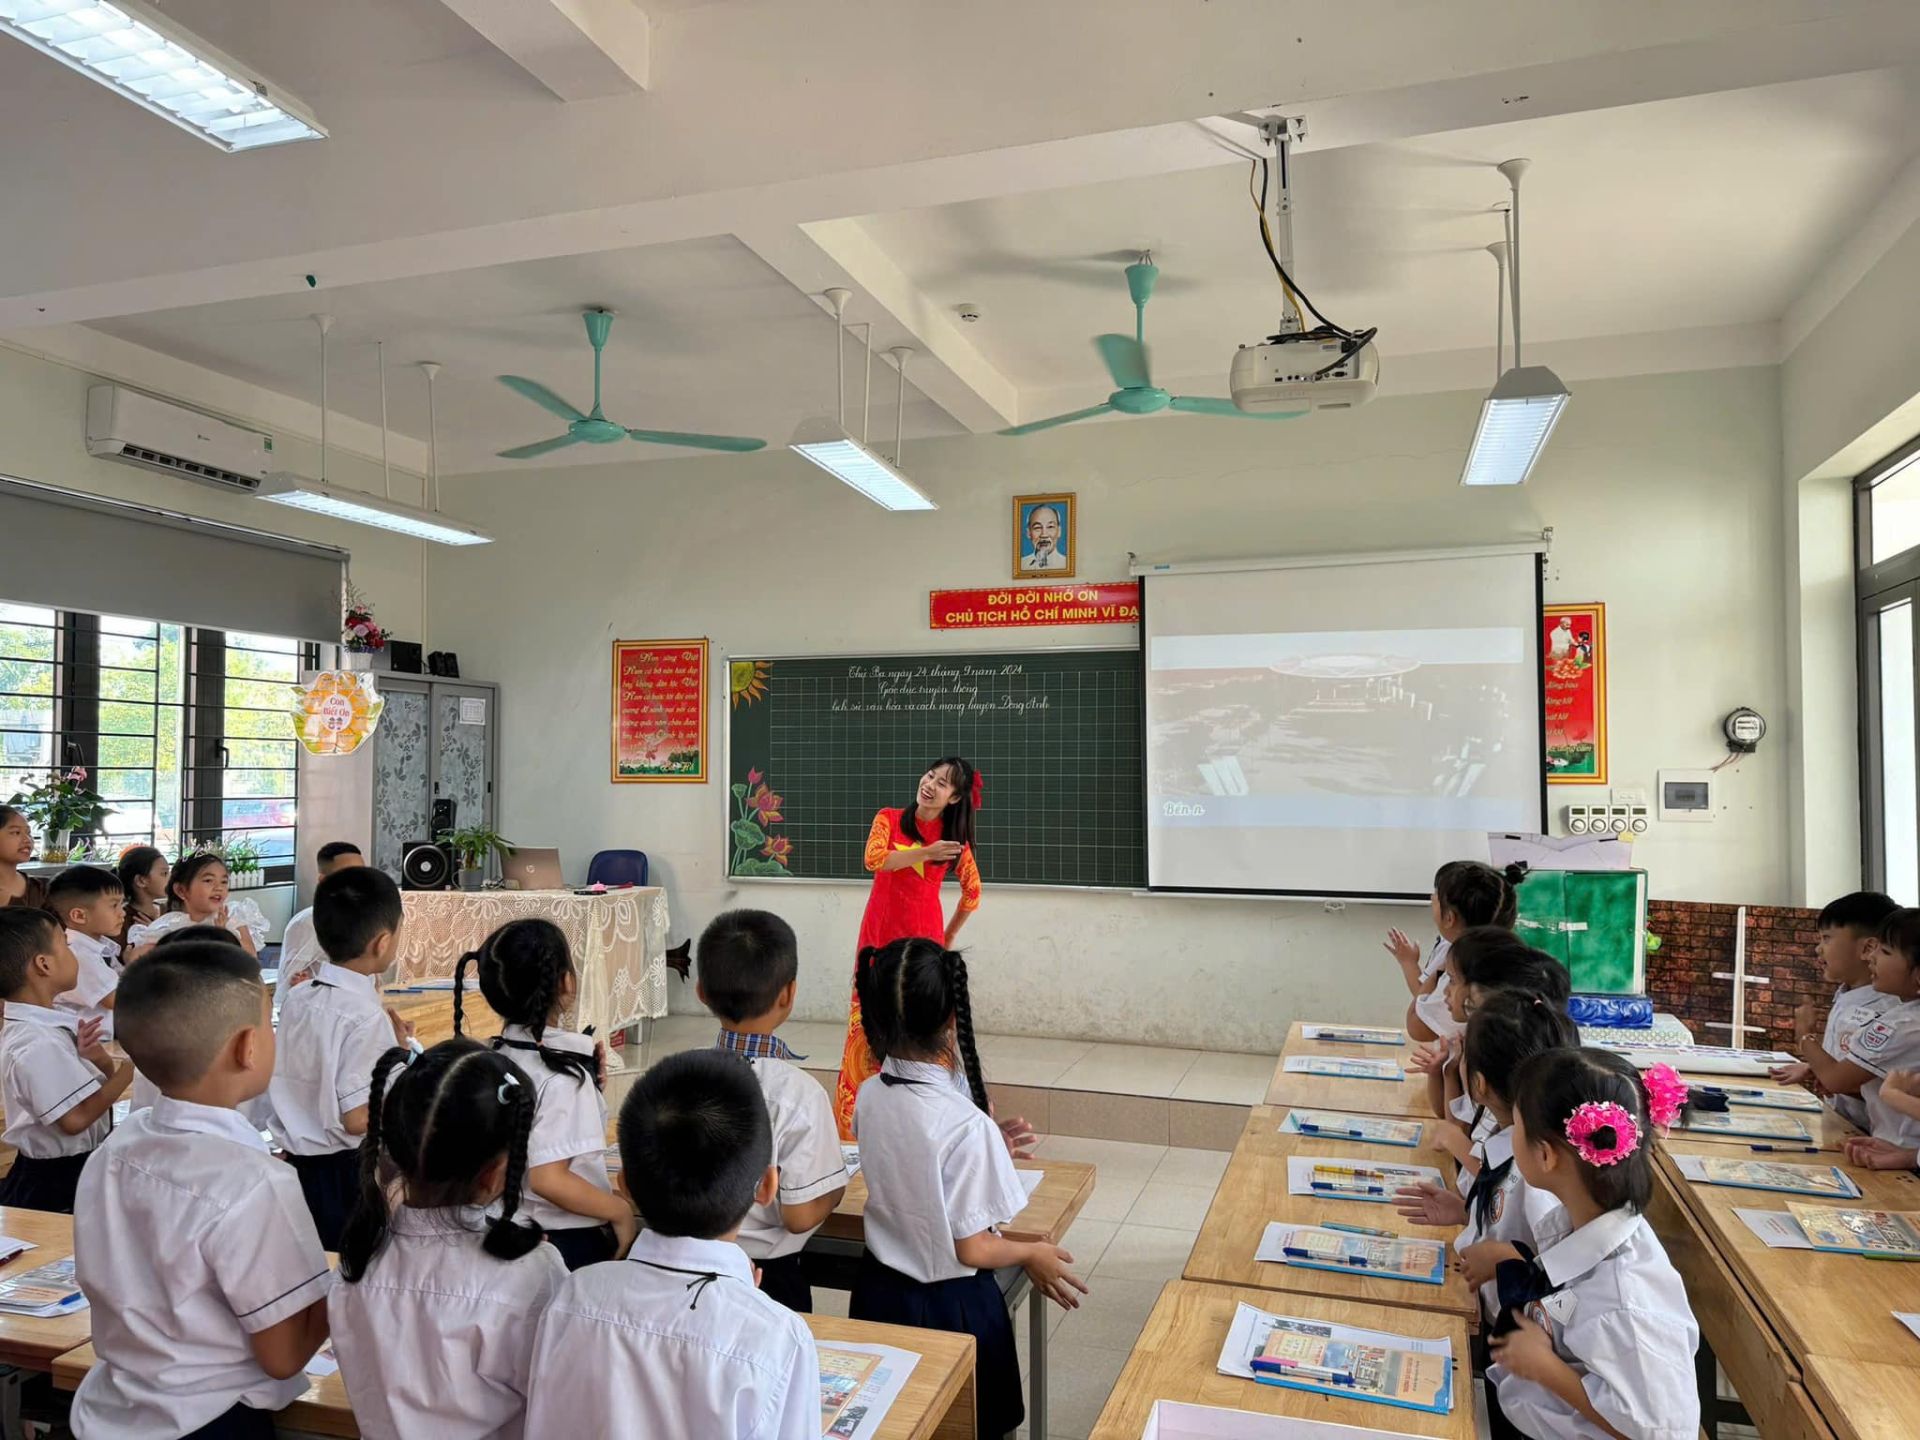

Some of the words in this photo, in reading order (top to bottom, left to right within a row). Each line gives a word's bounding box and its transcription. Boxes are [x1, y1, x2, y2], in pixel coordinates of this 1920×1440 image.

[988, 591, 1012, 605] ĐỜI
[1015, 590, 1040, 605] ĐỜI
[1043, 589, 1075, 603] NHỚ
[1077, 590, 1099, 602] ƠN
[945, 608, 973, 623] CHỦ
[977, 611, 1007, 624] TỊCH
[1010, 605, 1031, 621] HỒ
[1034, 606, 1059, 620] CHÍ
[1062, 607, 1098, 619] MINH
[1101, 605, 1116, 617] VĨ
[1119, 606, 1139, 619] ĐẠ
[1000, 664, 1023, 675] 2024
